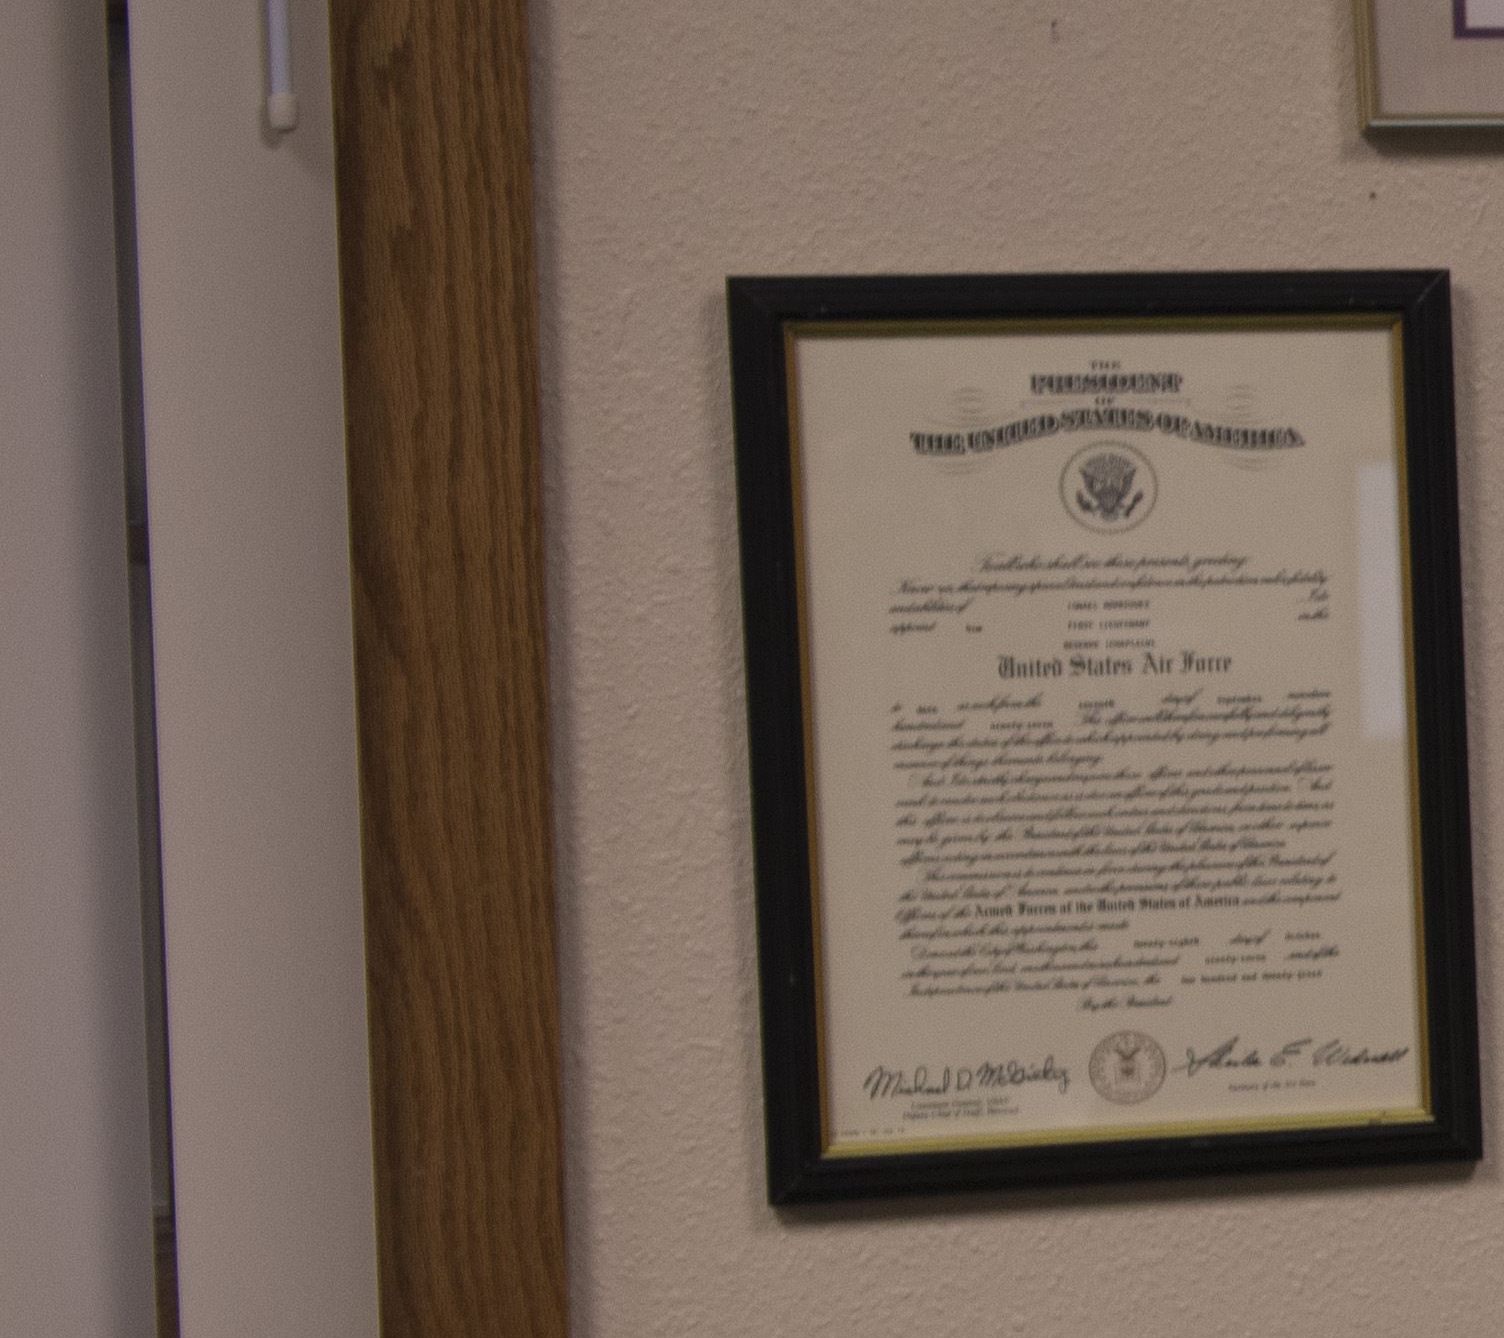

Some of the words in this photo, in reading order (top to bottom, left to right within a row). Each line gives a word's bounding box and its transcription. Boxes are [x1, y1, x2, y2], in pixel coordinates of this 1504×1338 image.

[1030, 374, 1183, 393] PRESIDENT
[997, 655, 1062, 680] United
[1069, 653, 1133, 677] States
[1141, 652, 1173, 675] Air
[1178, 650, 1232, 674] Force
